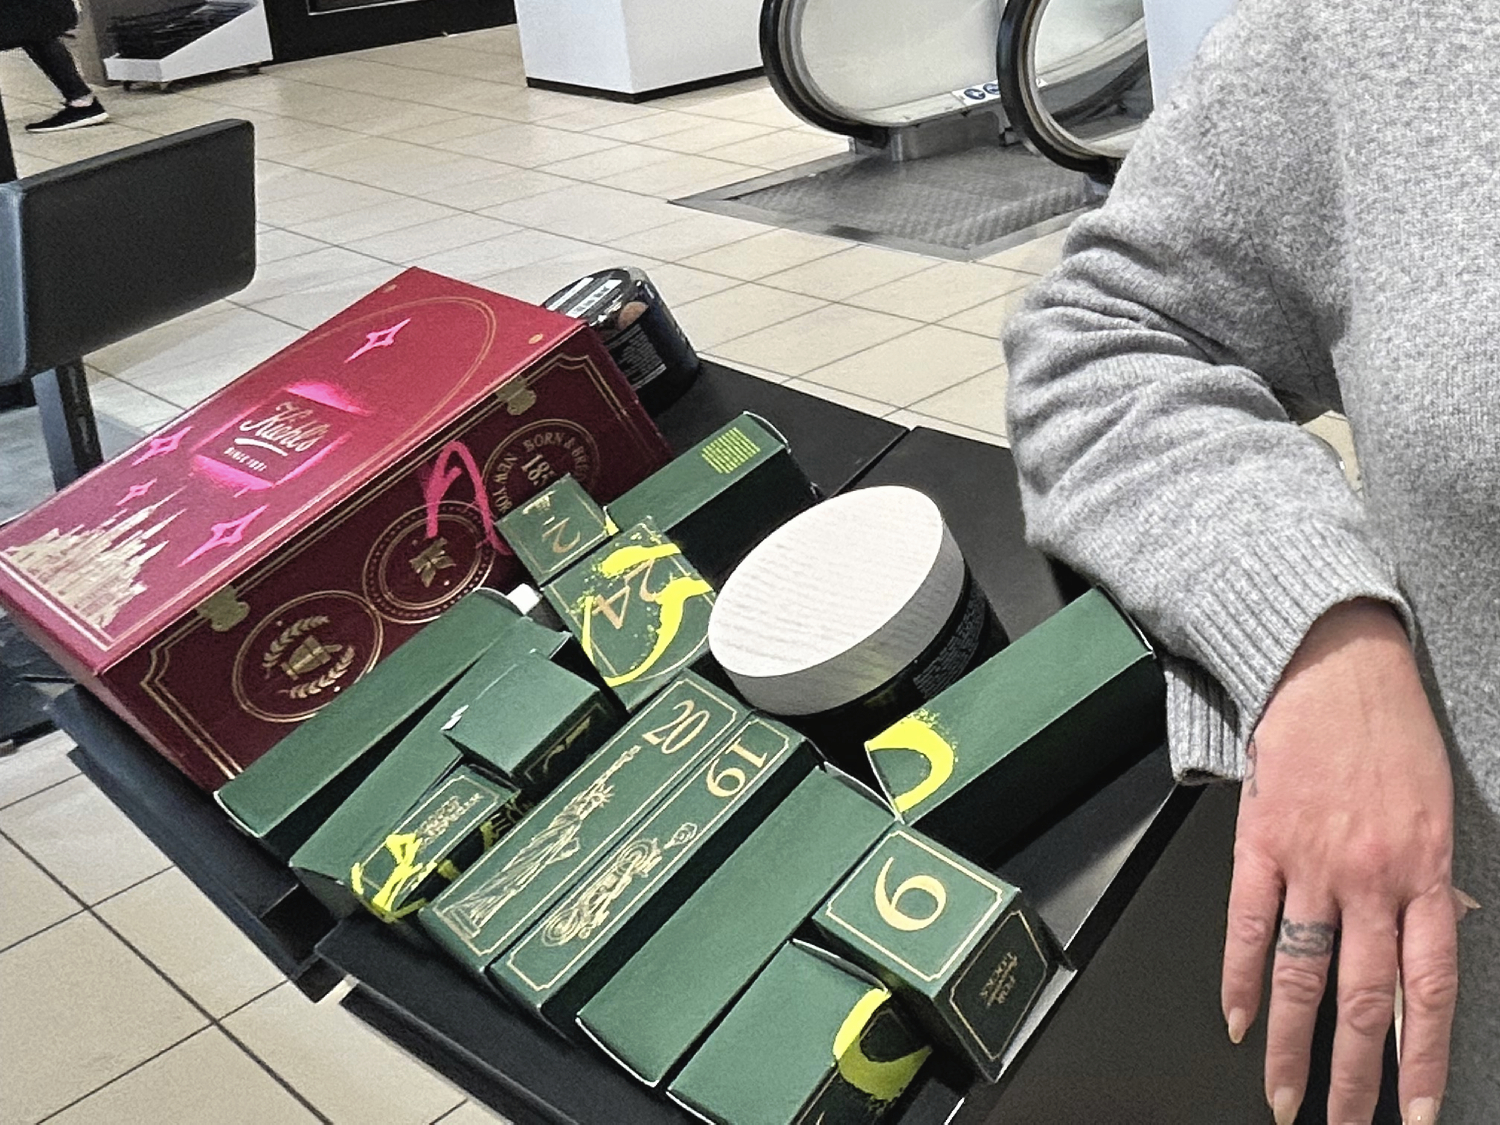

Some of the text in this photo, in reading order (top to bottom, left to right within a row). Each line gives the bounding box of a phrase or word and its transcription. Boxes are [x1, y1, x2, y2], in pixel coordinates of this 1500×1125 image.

[240, 401, 331, 452] Kiehl's
[522, 432, 564, 452] BORN
[492, 453, 518, 514] NEW YOR
[541, 517, 581, 554] 2
[639, 699, 711, 755] 20
[704, 735, 770, 800] 19
